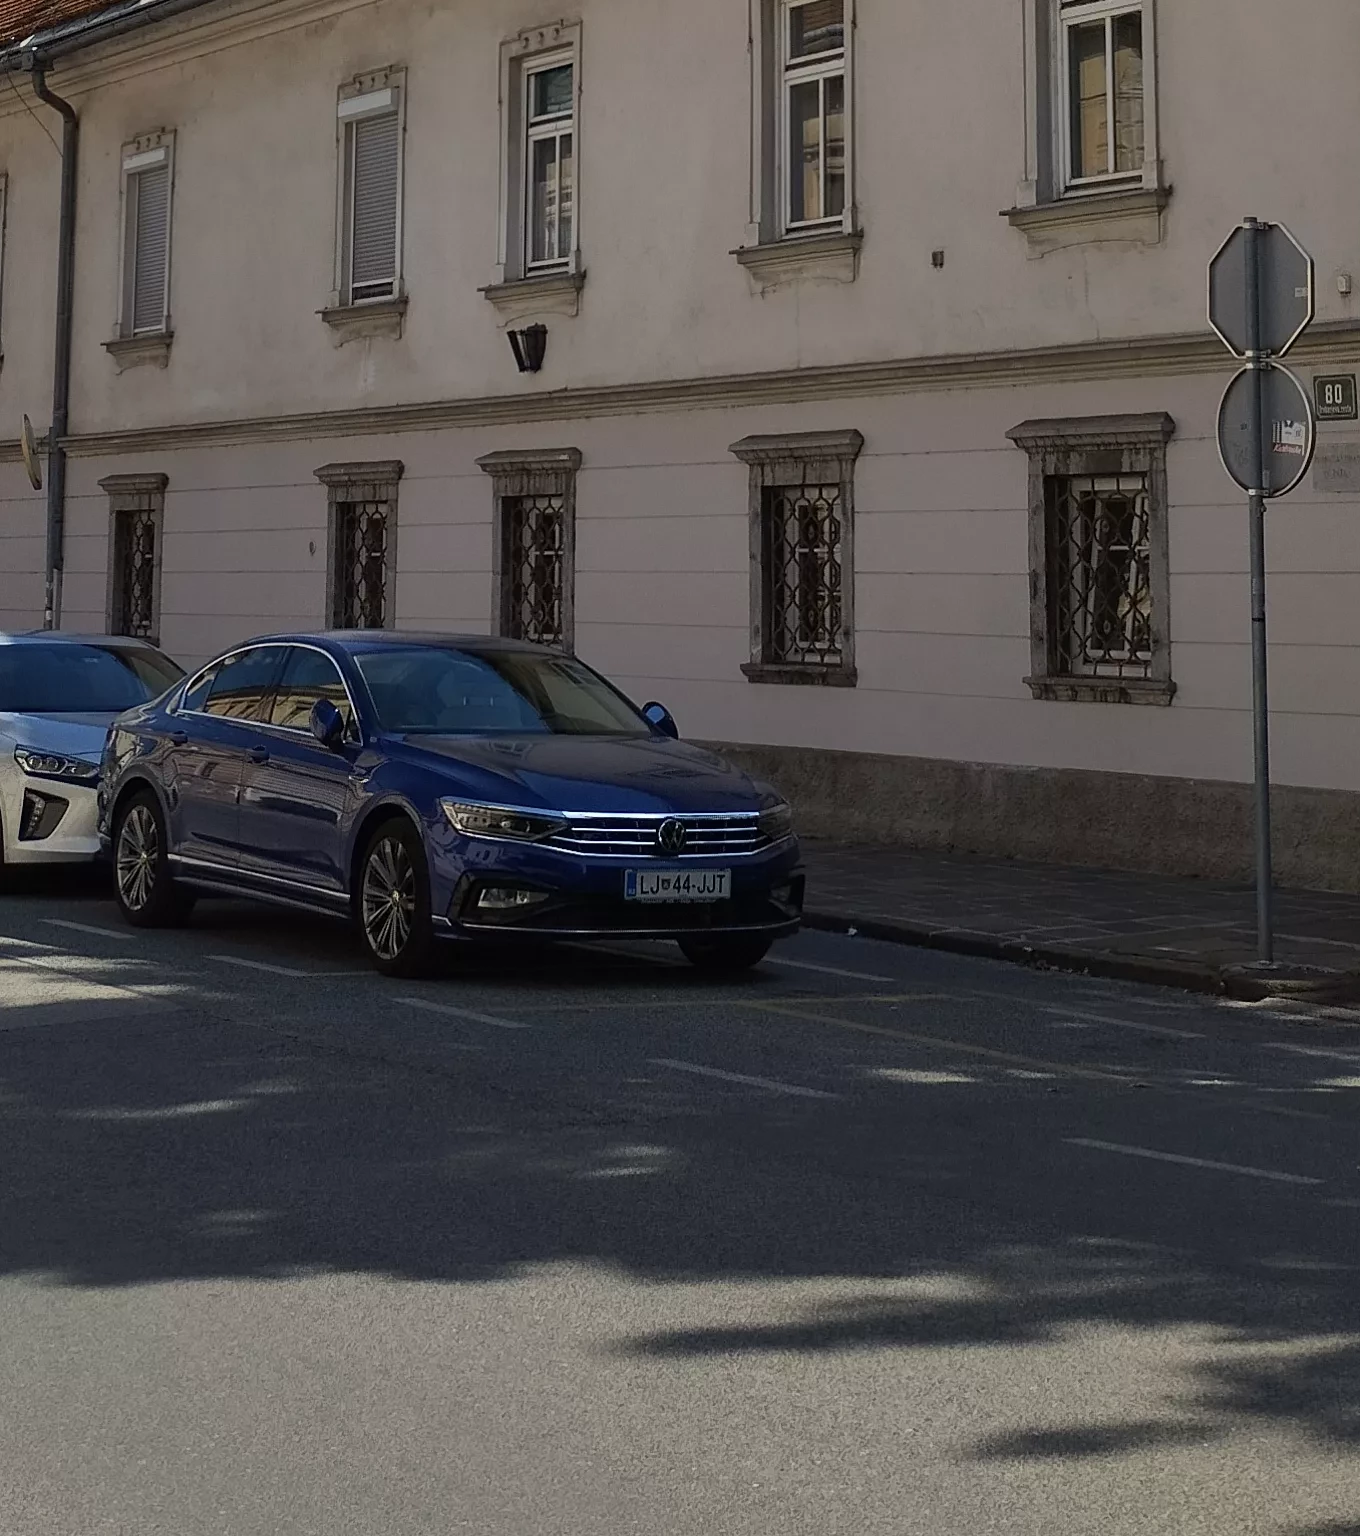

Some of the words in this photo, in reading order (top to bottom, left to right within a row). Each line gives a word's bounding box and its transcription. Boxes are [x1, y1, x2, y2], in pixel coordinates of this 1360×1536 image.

[1325, 384, 1342, 404] 80
[640, 875, 660, 895] LJ
[672, 874, 726, 894] 44-JJT
